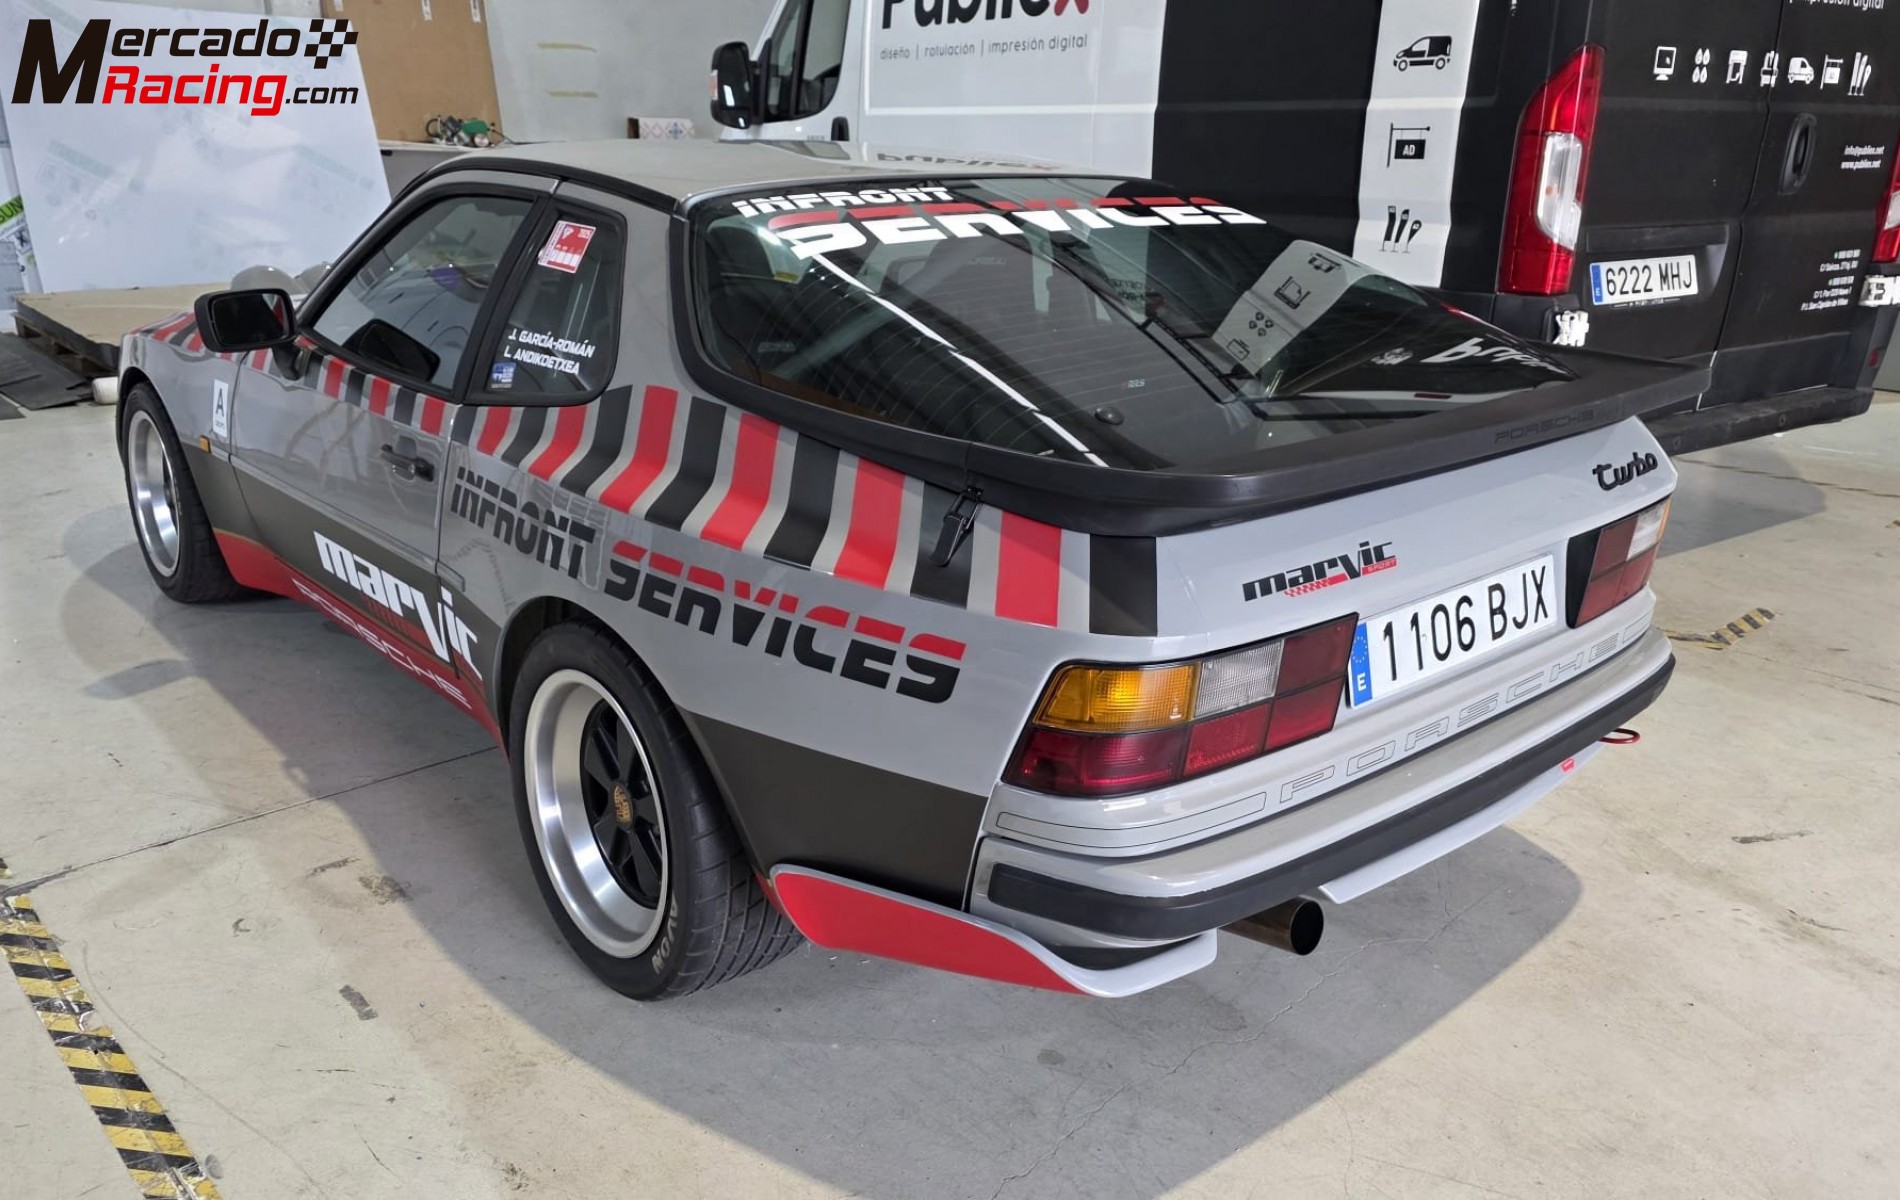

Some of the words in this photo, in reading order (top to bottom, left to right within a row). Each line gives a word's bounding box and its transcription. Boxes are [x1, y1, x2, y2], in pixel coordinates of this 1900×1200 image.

[880, 47, 910, 60] diseño
[924, 42, 975, 58] rotulación
[988, 37, 1045, 54] impresión
[1048, 33, 1088, 53] digital
[1605, 264, 1654, 296] 6222
[1658, 260, 1692, 291] MHJ
[519, 330, 596, 358] GARCÍA-ROMÁN
[215, 388, 225, 417] A
[1494, 409, 1594, 444] PORSCHE
[1367, 558, 1397, 573] SPORT
[603, 540, 967, 703] SERVICES
[1356, 672, 1367, 692] E
[1382, 594, 1476, 682] 1106
[1487, 564, 1549, 642] BJX
[292, 577, 473, 711] PORSCHE
[1279, 632, 1619, 804] PORSCHE
